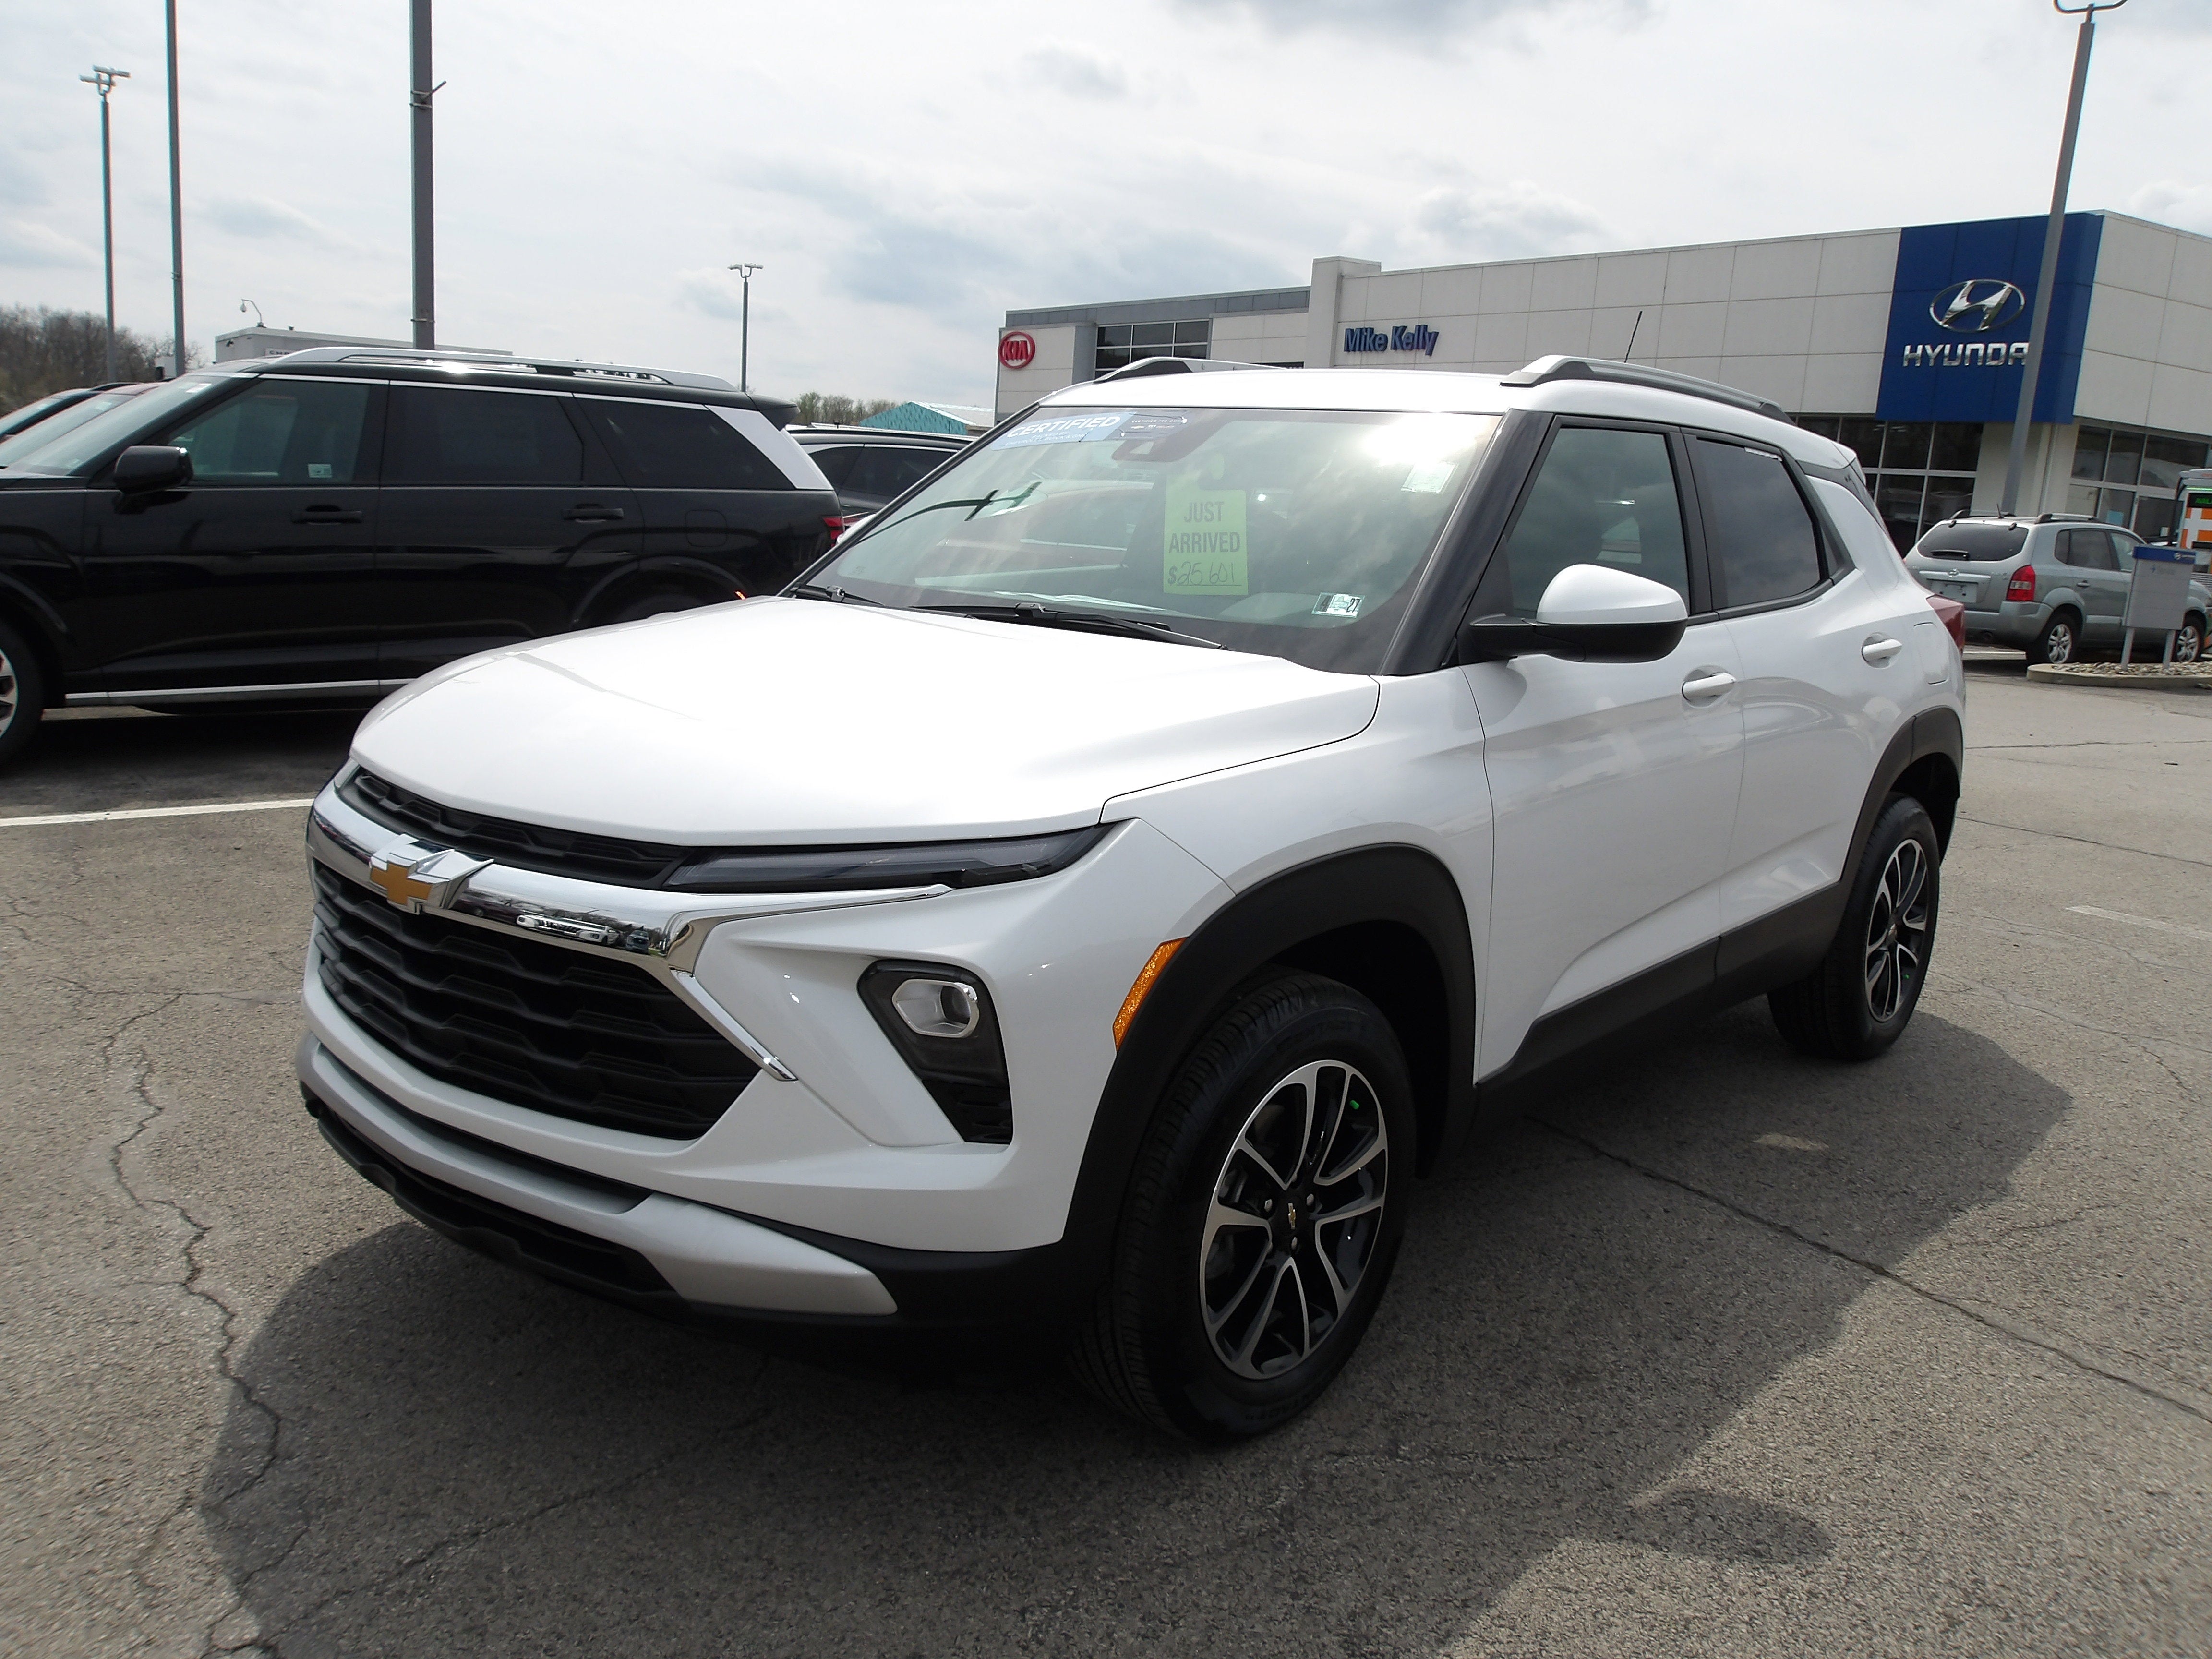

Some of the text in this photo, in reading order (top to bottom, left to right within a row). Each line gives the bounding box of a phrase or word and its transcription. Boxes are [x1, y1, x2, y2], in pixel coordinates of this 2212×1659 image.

[1004, 340, 1028, 361] KIA
[1344, 325, 1439, 356] Mike Kelly
[1902, 342, 2030, 367] HYUNDA
[1007, 416, 1121, 438] CERTIFIED
[1184, 501, 1224, 523] JUST
[1169, 531, 1240, 553] ARRIVED
[1346, 598, 1361, 613] 27
